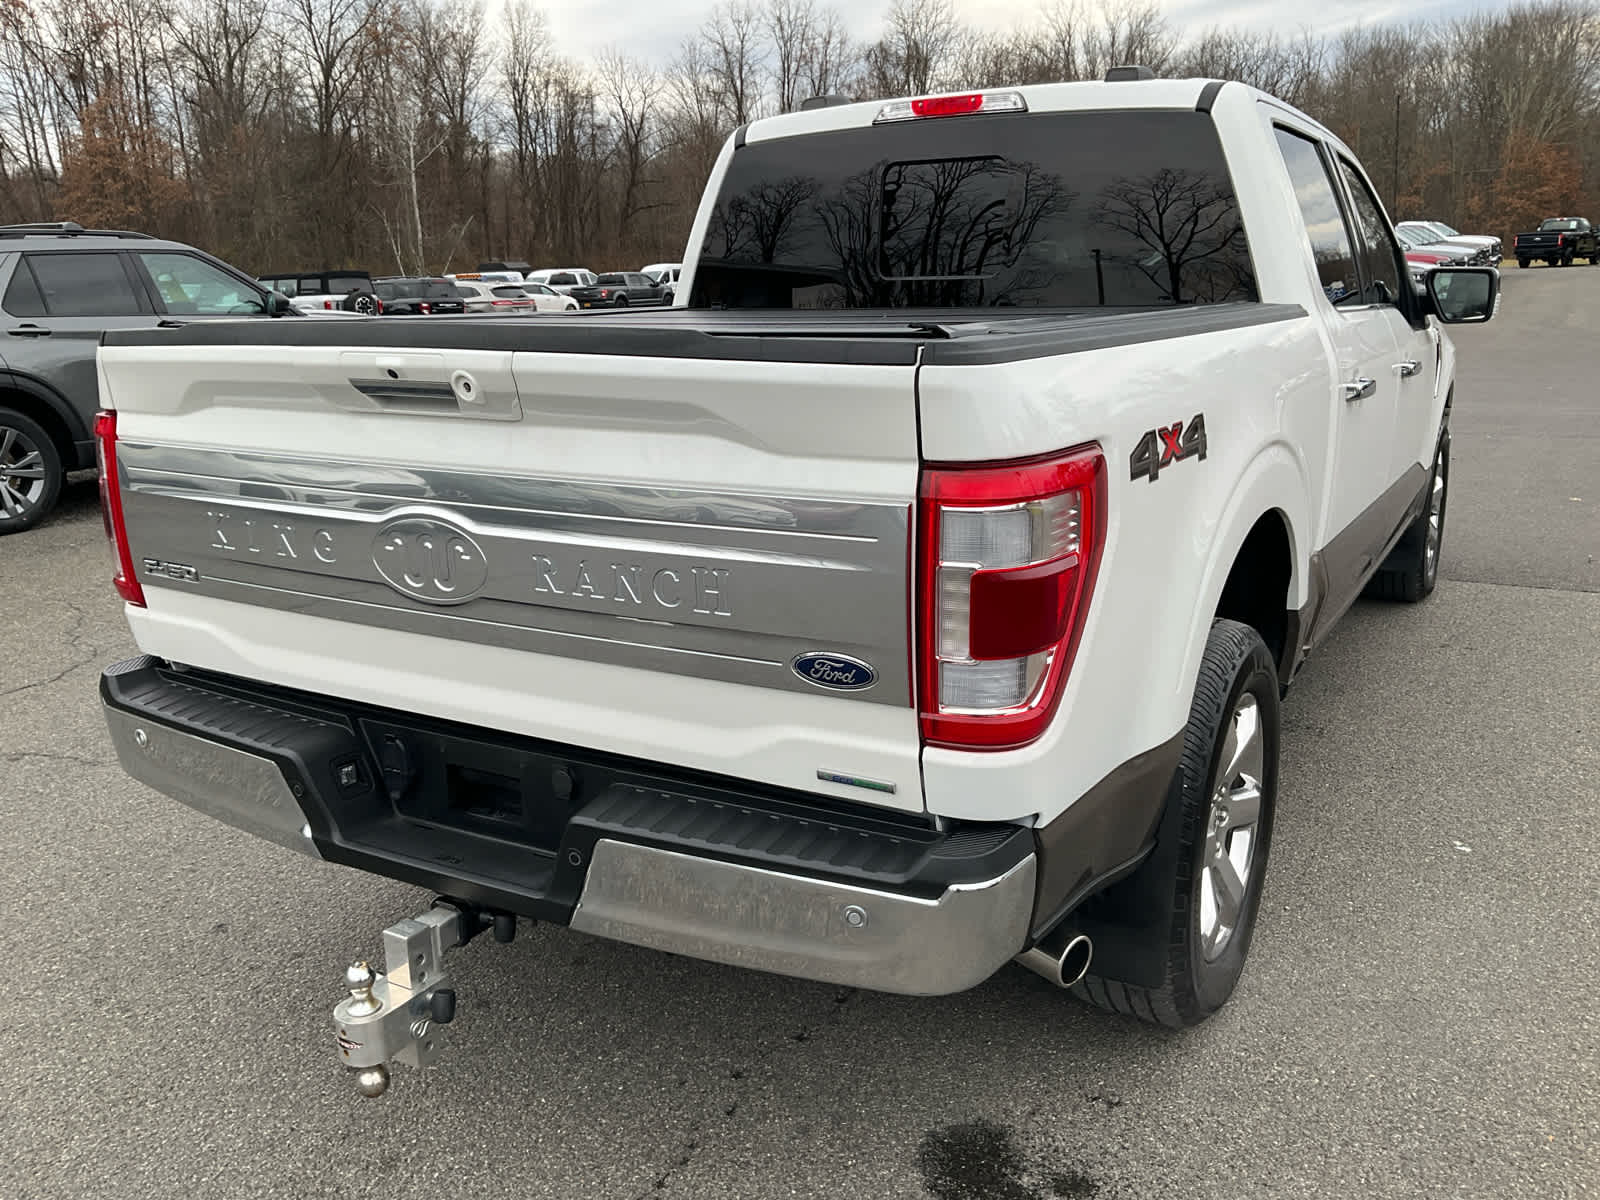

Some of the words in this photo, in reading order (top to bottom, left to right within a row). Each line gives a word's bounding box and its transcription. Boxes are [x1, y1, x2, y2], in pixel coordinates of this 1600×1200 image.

[207, 510, 337, 563] KING
[532, 554, 732, 616] RANCH
[810, 659, 858, 683] Ford
